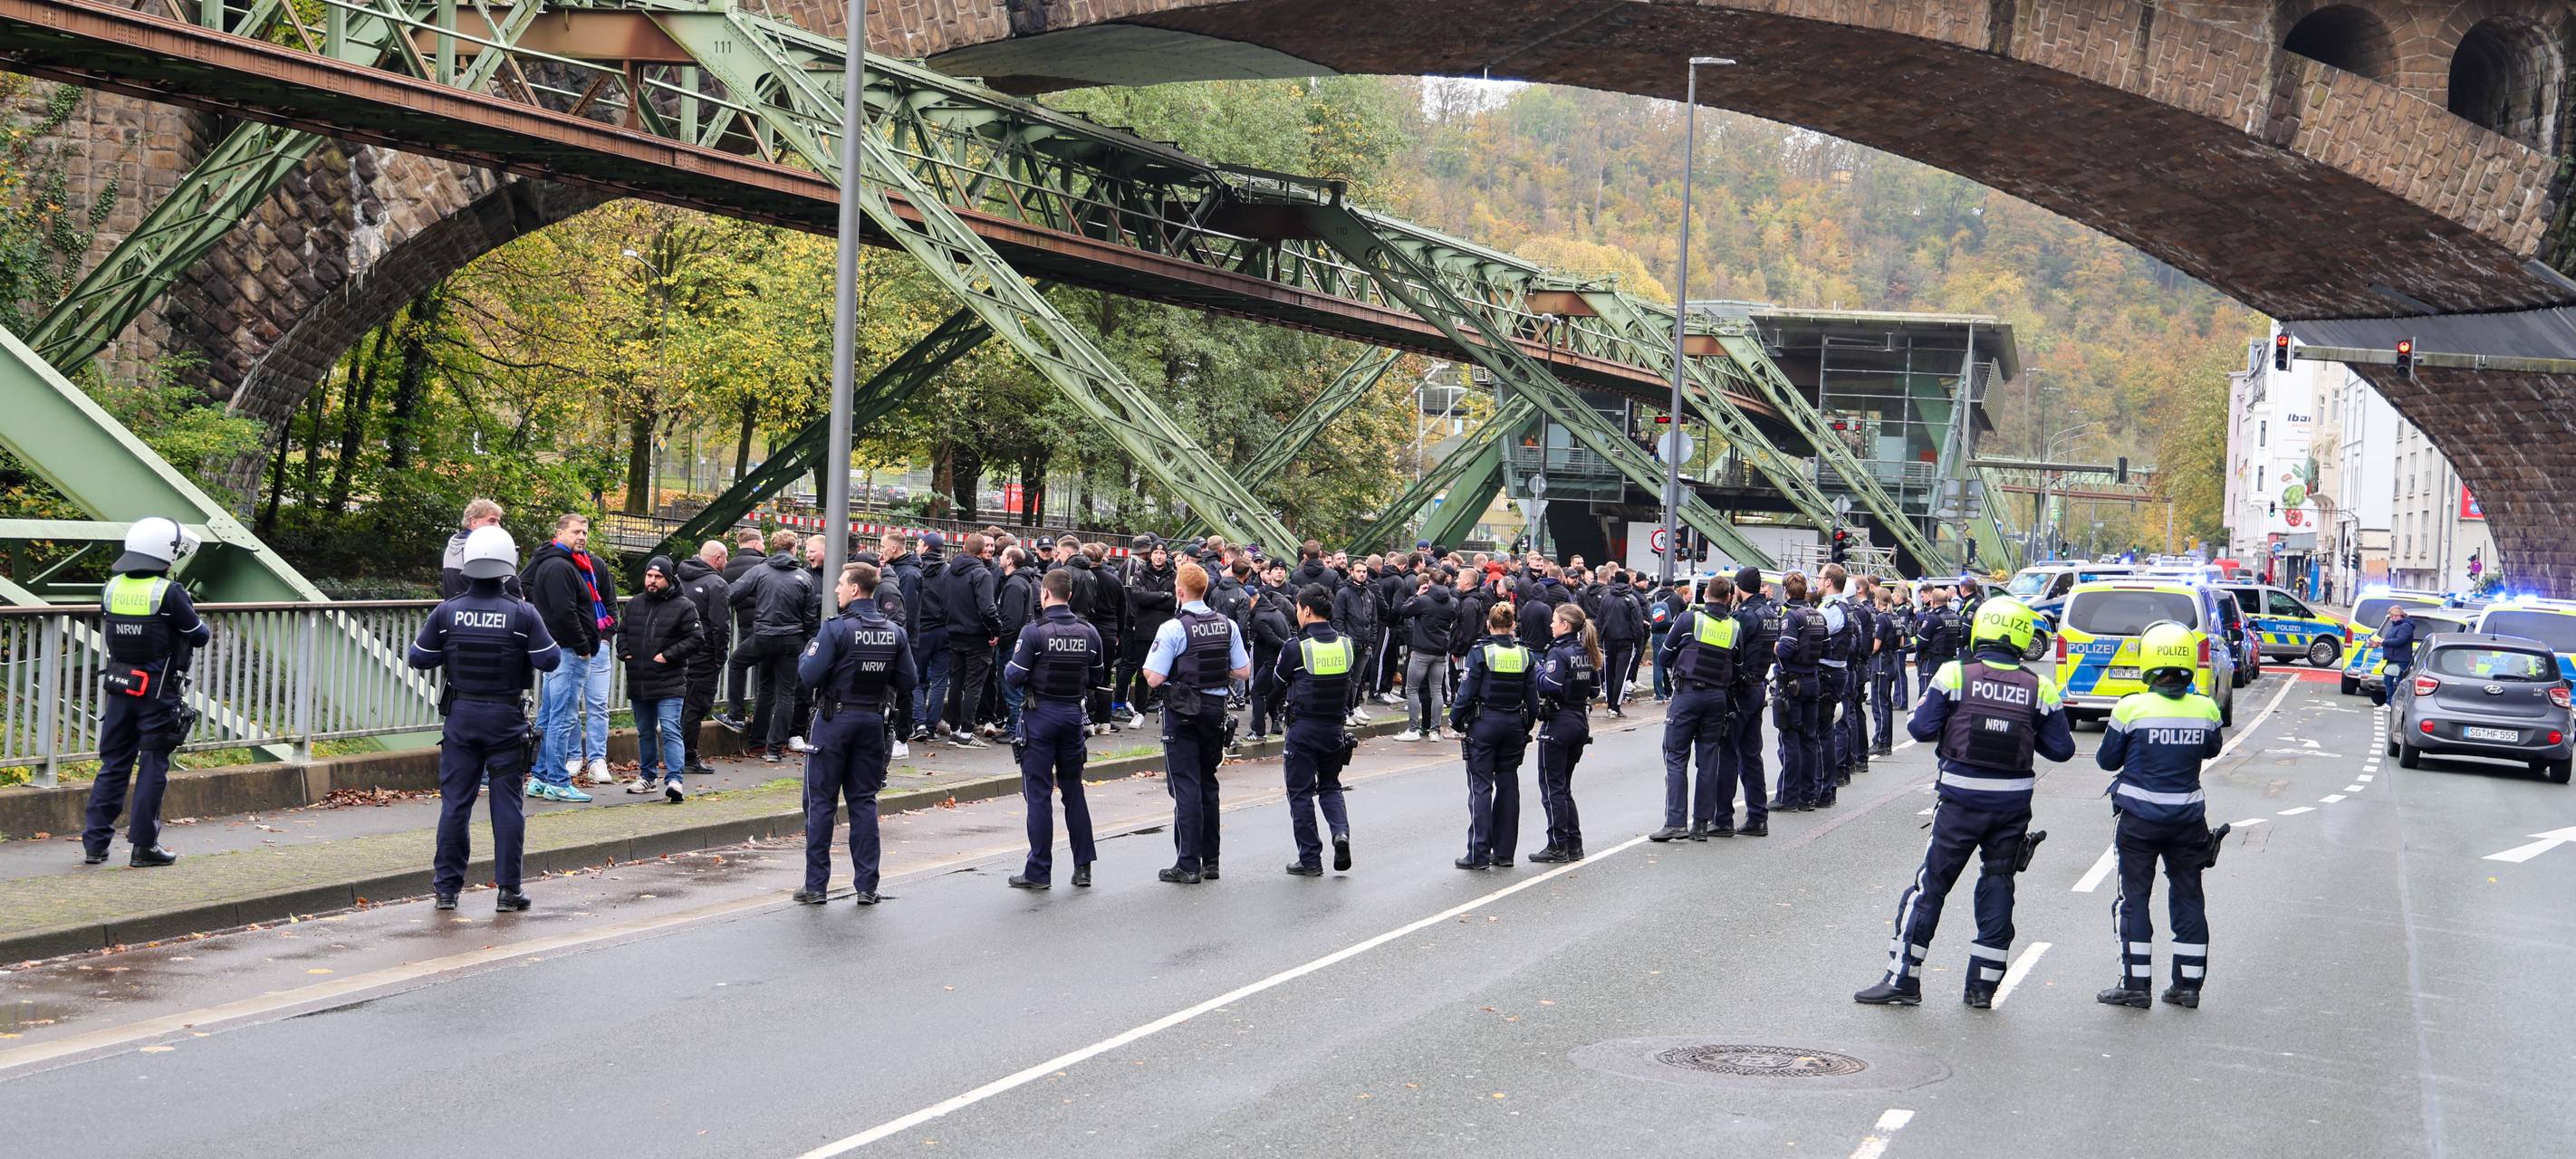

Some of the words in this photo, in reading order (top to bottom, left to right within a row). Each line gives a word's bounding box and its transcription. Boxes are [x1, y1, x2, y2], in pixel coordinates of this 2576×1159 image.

[714, 41, 732, 53] 111
[114, 593, 149, 606] POLIZEI
[455, 611, 506, 628] POLIZEI
[1982, 613, 2031, 634] POLIZE
[116, 624, 142, 635] NRW
[1191, 622, 1228, 637] POLIZEI
[1705, 627, 1729, 640] POLIZEI
[855, 630, 896, 646] POLIZEI
[1048, 637, 1087, 652] POLIZEI
[2068, 643, 2115, 654] POLIZEI
[2157, 646, 2190, 656] POLIZEI
[861, 661, 886, 672] NRW
[1316, 656, 1345, 667] POLIZEI
[1495, 658, 1523, 670] POLIZEI
[1571, 656, 1592, 668] POLIZ
[1576, 671, 1591, 680] NRW
[2113, 669, 2126, 677] NRW
[1971, 680, 2030, 705] POLIZEI
[1985, 718, 2009, 733] NRW
[2148, 728, 2206, 745] POLIZEI
[2469, 728, 2482, 737] SG
[2486, 729, 2499, 738] HF
[2500, 731, 2516, 741] 555
